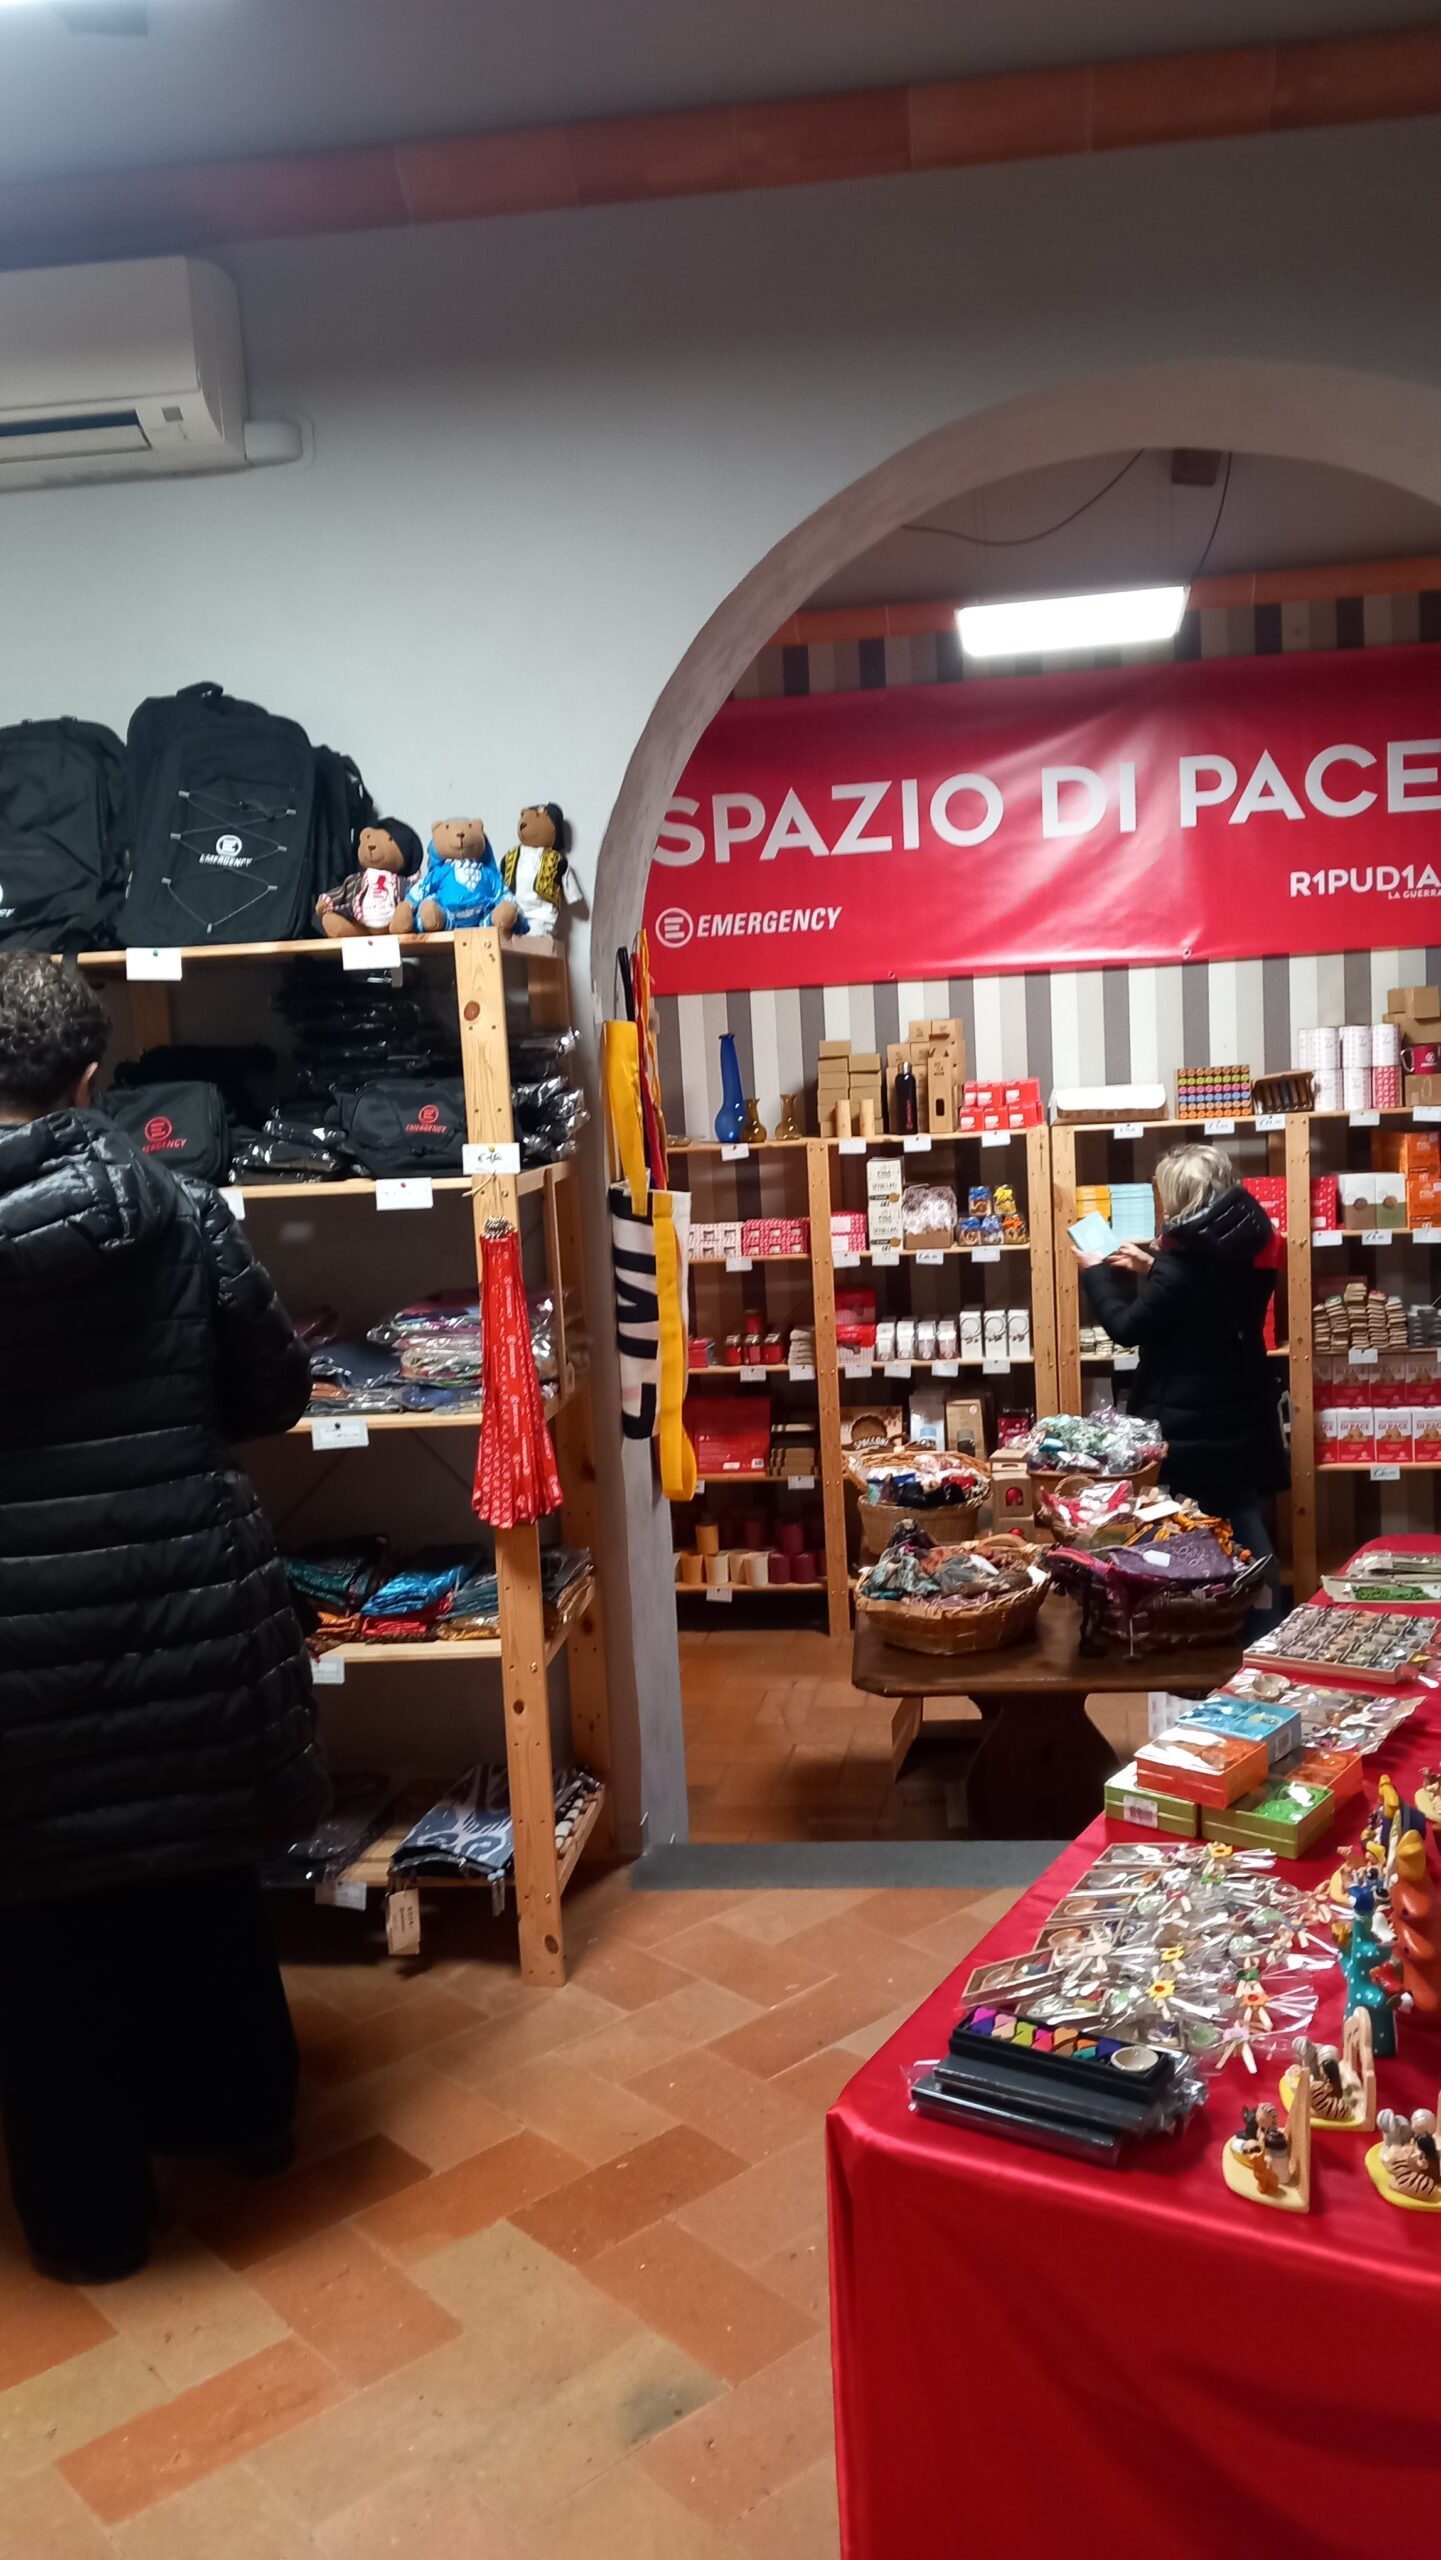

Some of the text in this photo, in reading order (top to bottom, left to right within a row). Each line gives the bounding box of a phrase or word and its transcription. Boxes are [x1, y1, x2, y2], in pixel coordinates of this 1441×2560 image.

[652, 738, 1441, 867] SPAZIO DI PACE
[1290, 863, 1441, 898] R1PUD1A
[1388, 891, 1400, 900] LA
[697, 906, 842, 938] EMERGENCY
